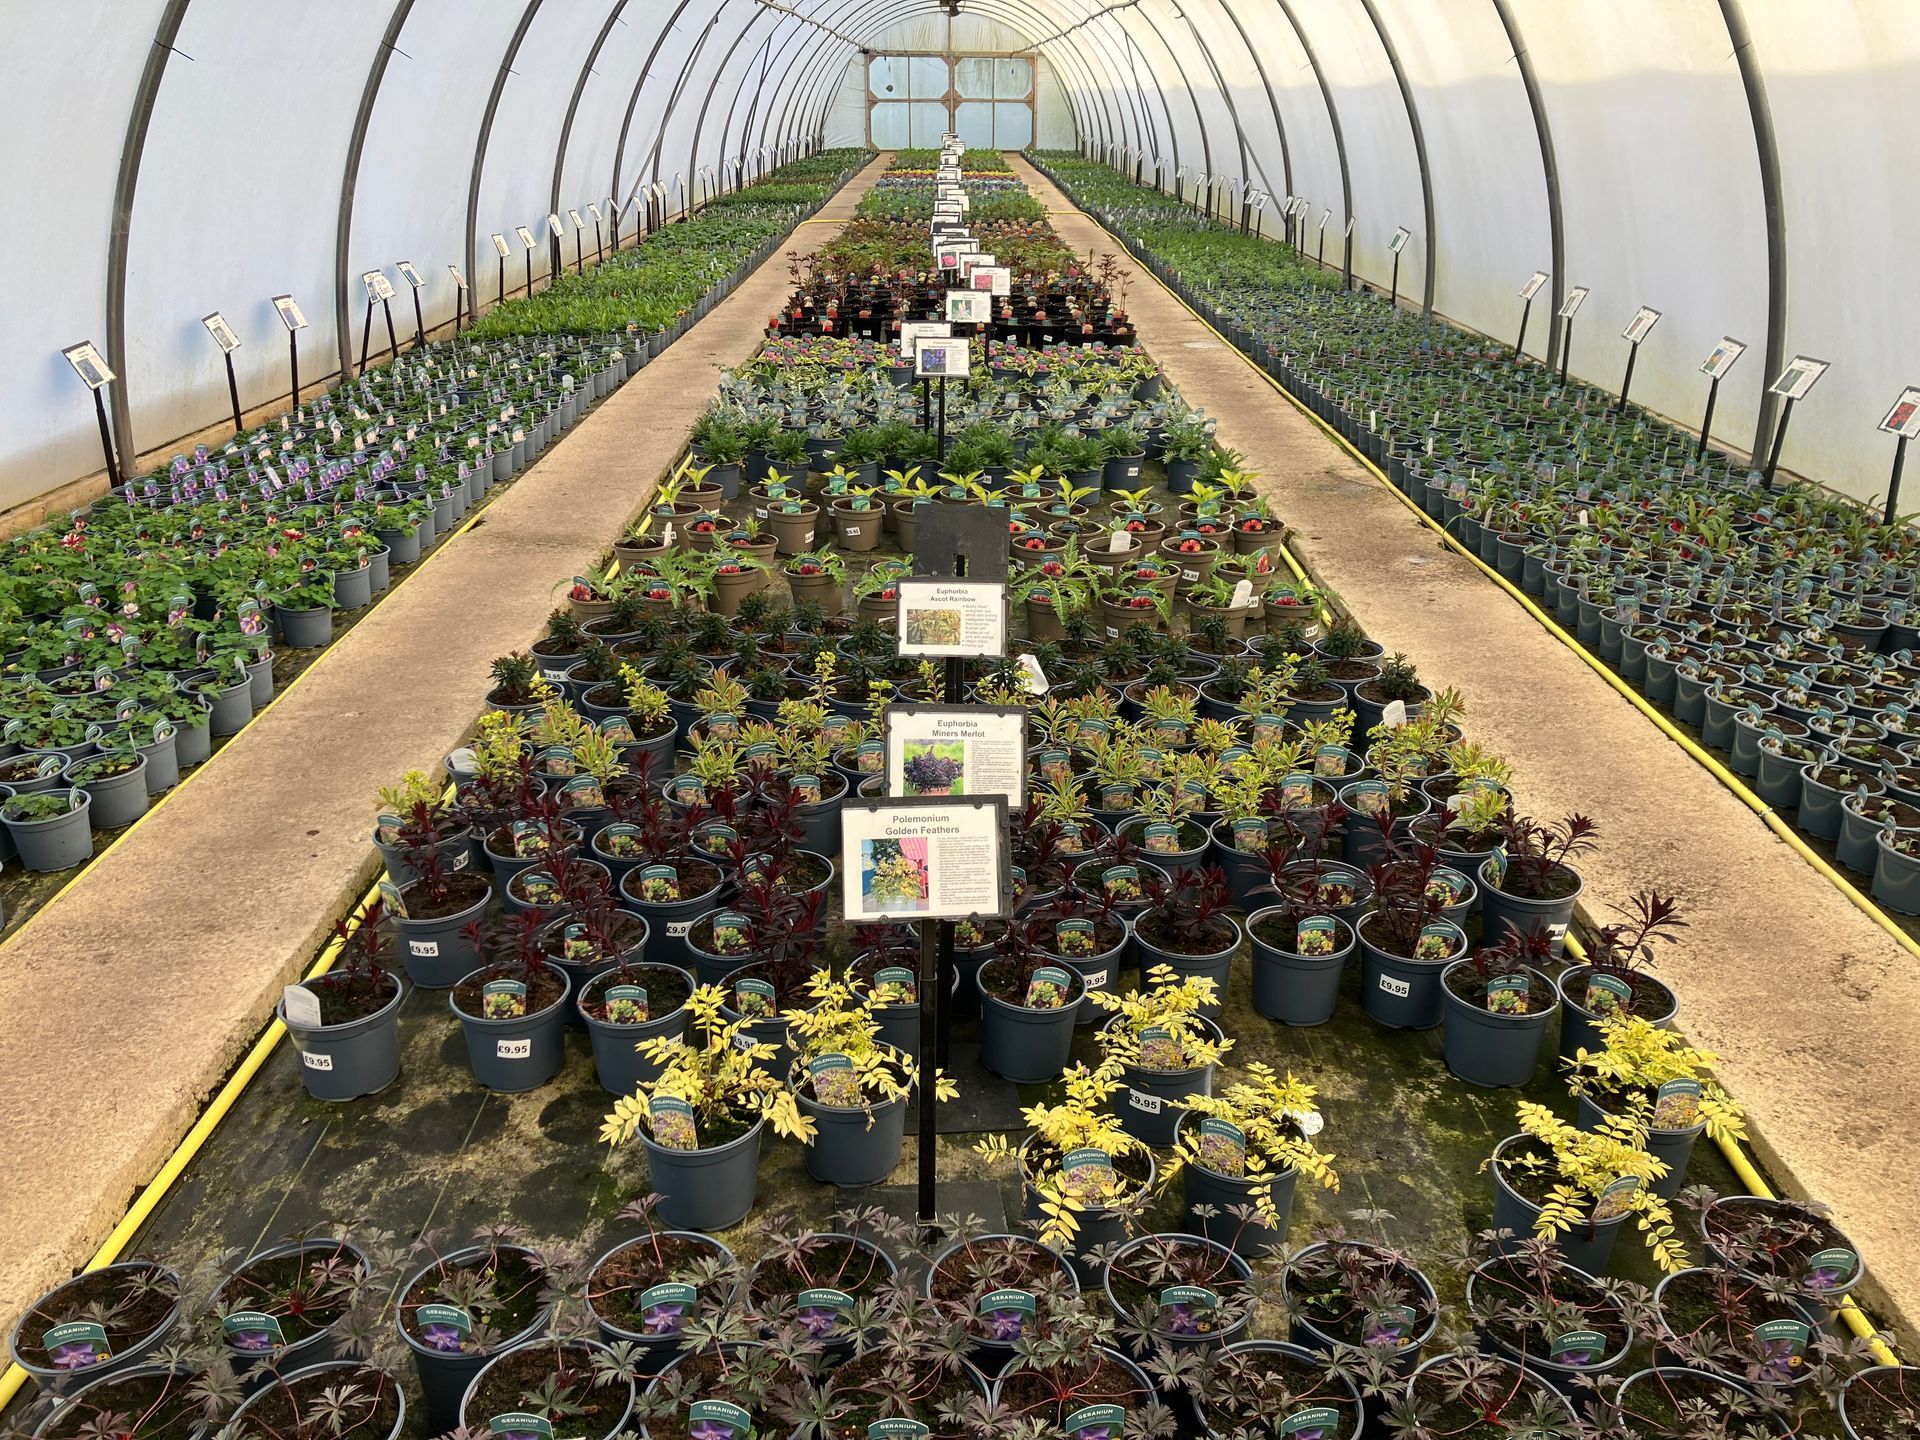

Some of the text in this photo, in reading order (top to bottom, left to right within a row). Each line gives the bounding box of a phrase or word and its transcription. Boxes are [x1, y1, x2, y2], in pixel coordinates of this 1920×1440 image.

[937, 720, 978, 728] Euphorbia
[892, 814, 950, 823] Polemonium
[885, 826, 960, 835] Golden Feathers
[667, 926, 687, 934] £9.9
[411, 945, 436, 955] £9.95
[1040, 970, 1066, 979] EUPHORBIA
[1086, 975, 1105, 987] 9.95
[1381, 979, 1407, 995] £9.95
[498, 1045, 528, 1054] £9.95
[304, 1056, 330, 1067] £9.95
[813, 1057, 847, 1066] POLEMONIUM
[1129, 1093, 1157, 1109] £9.95
[1206, 1122, 1241, 1136] POLEMONIUM
[1068, 1153, 1106, 1161] POLEMONIUM
[652, 1288, 686, 1296] GERANIUM
[426, 1309, 458, 1317] GERANIUM
[54, 1327, 91, 1336] GERANIUM
[703, 1405, 739, 1416] GERANIUM
[1078, 1409, 1114, 1419] GERANIUM
[1293, 1412, 1329, 1423] GERANIUM
